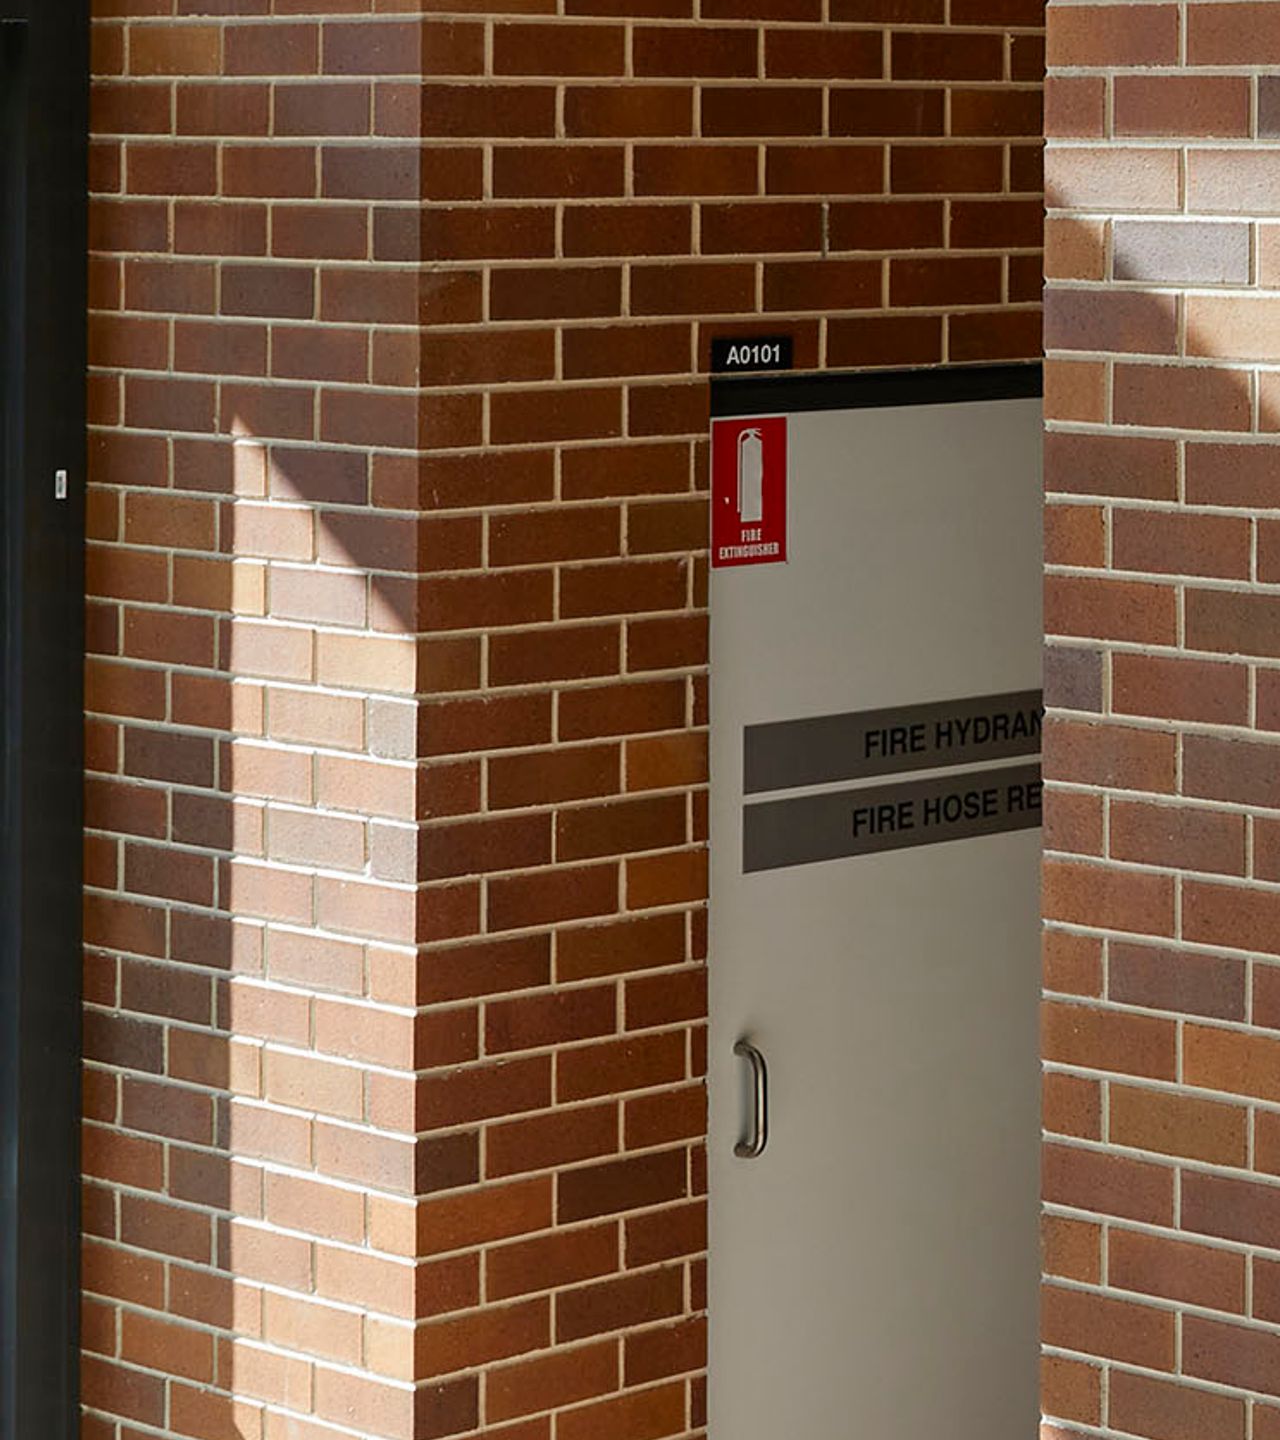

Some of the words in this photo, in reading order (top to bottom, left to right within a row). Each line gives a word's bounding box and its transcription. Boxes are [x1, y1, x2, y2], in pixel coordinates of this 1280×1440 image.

[726, 344, 779, 365] A0101
[741, 528, 762, 543] FIRE
[719, 542, 779, 560] EXTINGUISHER
[865, 724, 926, 759] FIRE
[852, 801, 914, 838] FIRE
[923, 789, 999, 827] HOSE
